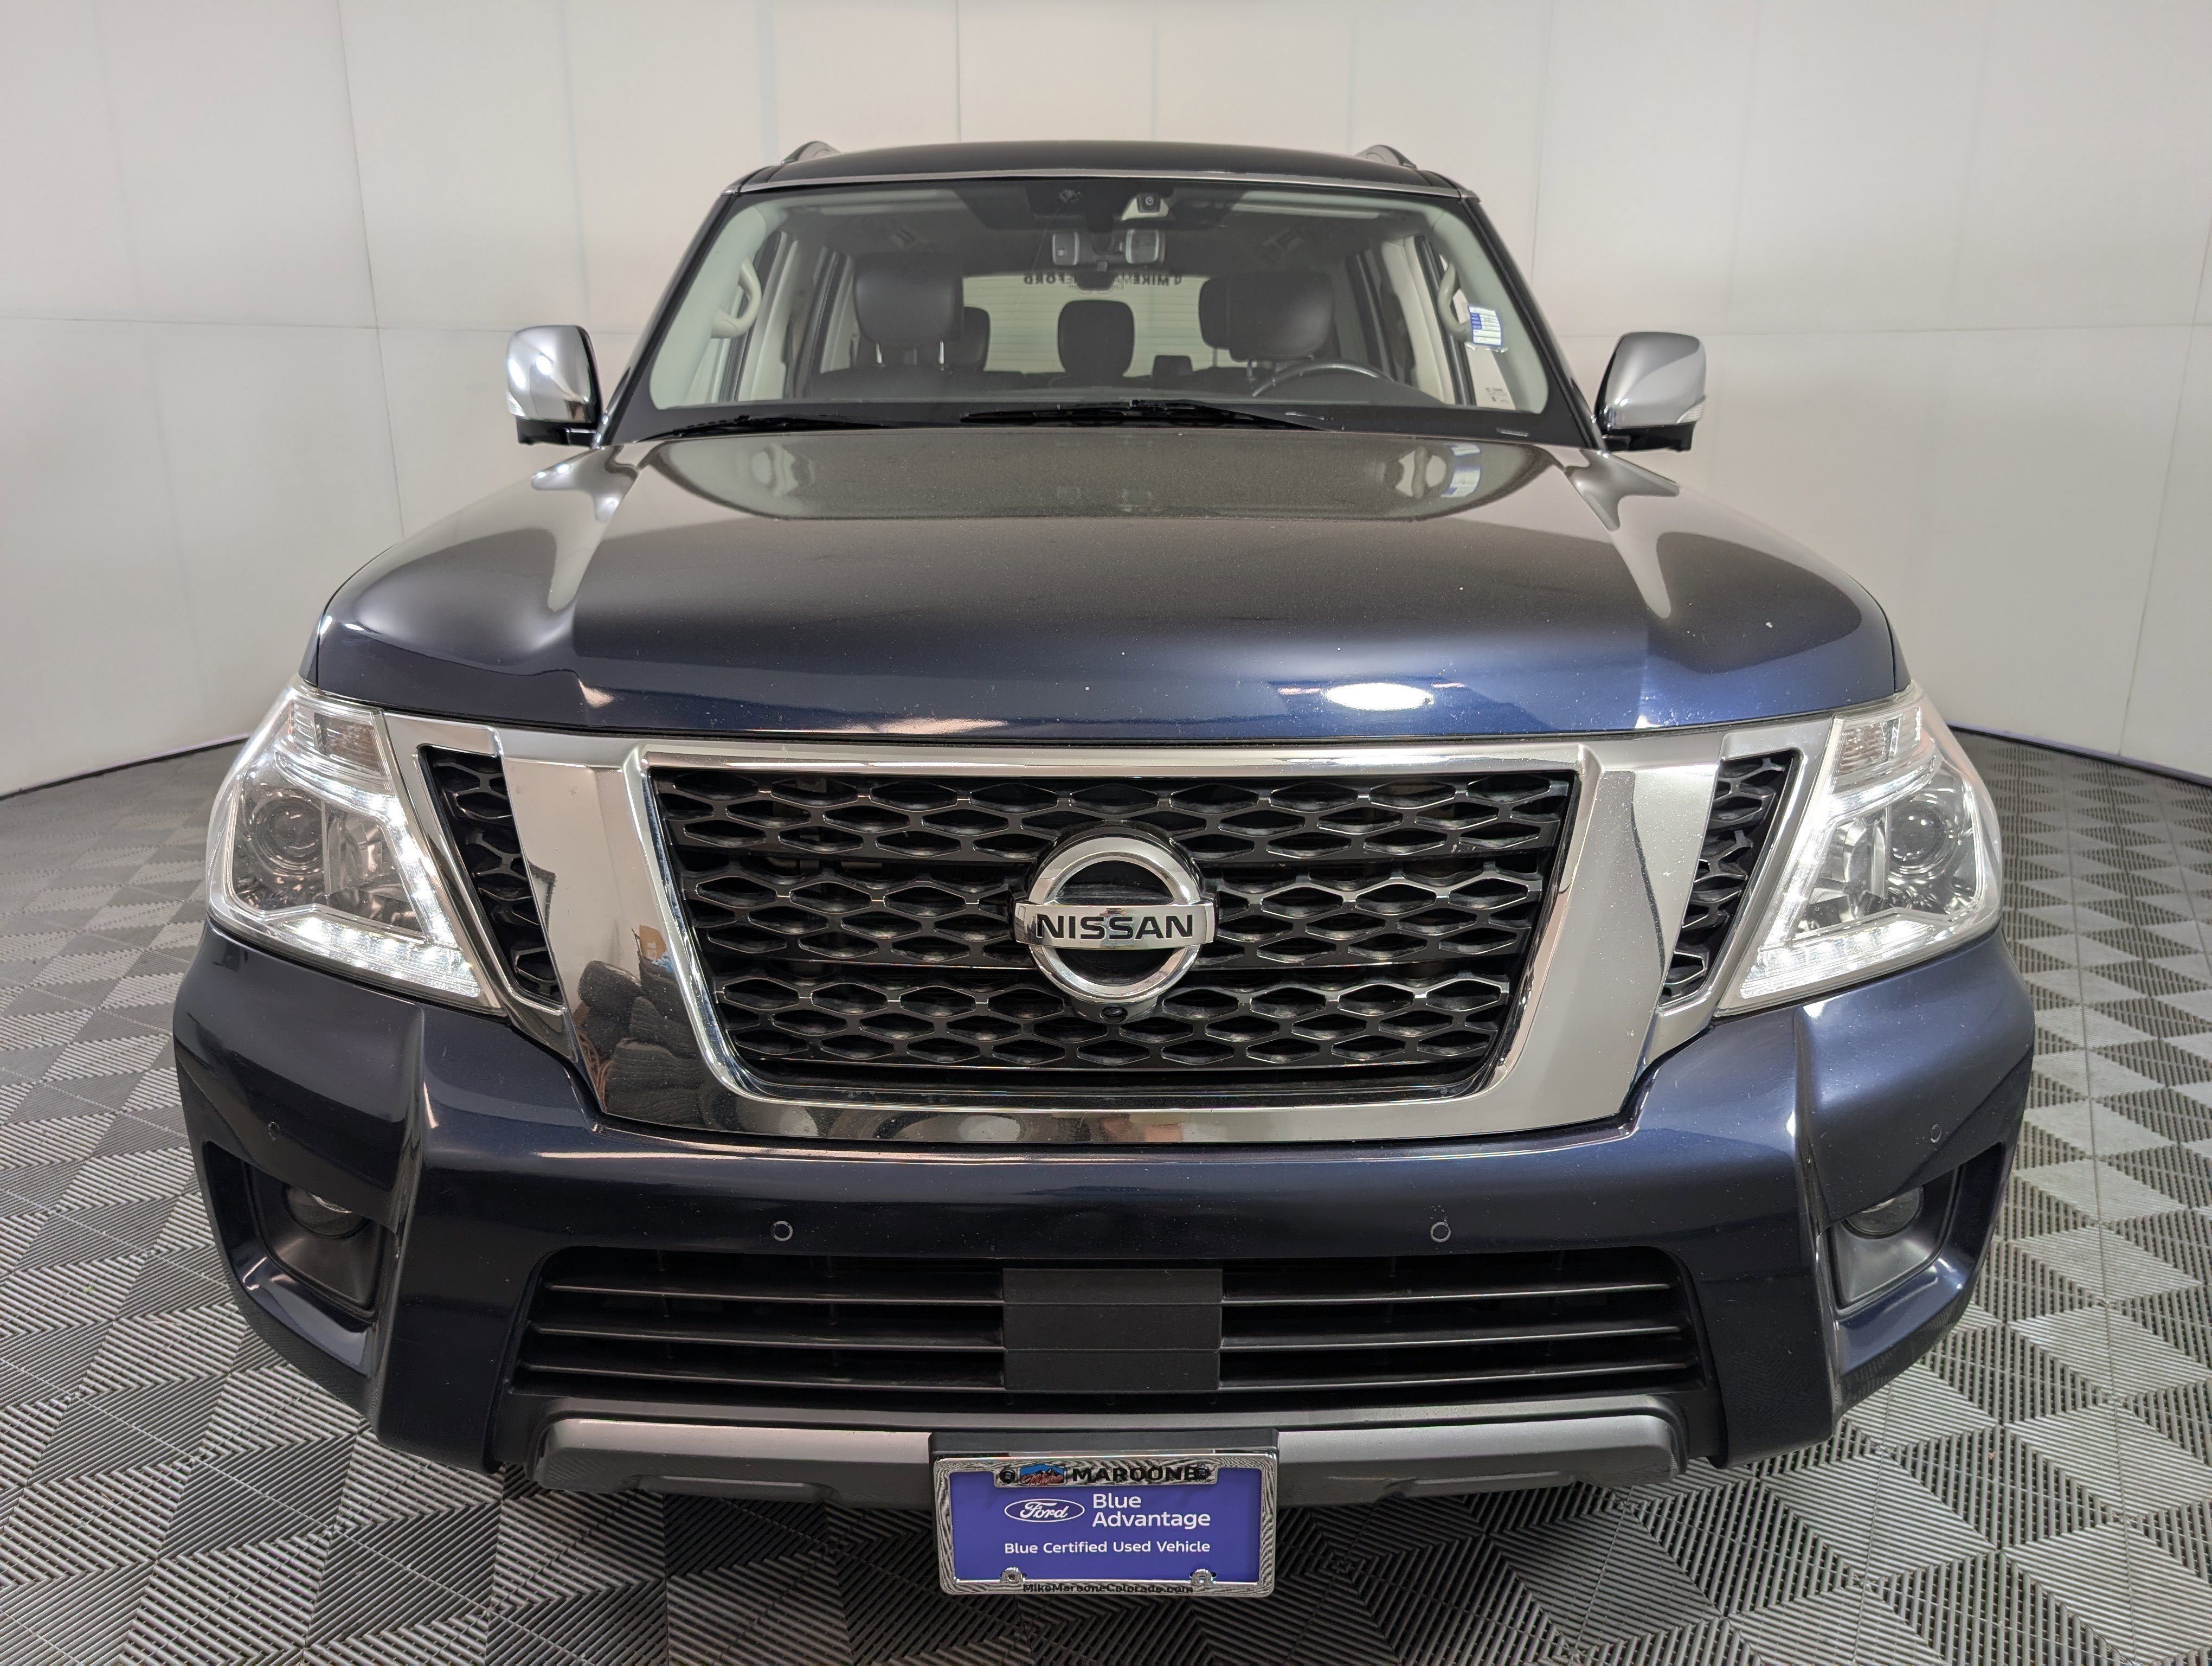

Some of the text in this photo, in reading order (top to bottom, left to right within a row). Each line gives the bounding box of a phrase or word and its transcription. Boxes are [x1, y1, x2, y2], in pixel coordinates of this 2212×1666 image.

[1036, 914, 1193, 940] NISSAN
[1093, 1494, 1142, 1509] Blue
[1020, 1502, 1069, 1519] Ford
[1092, 1511, 1211, 1530] Advantage
[1004, 1541, 1211, 1554] Blue Certified Used Vehicle
